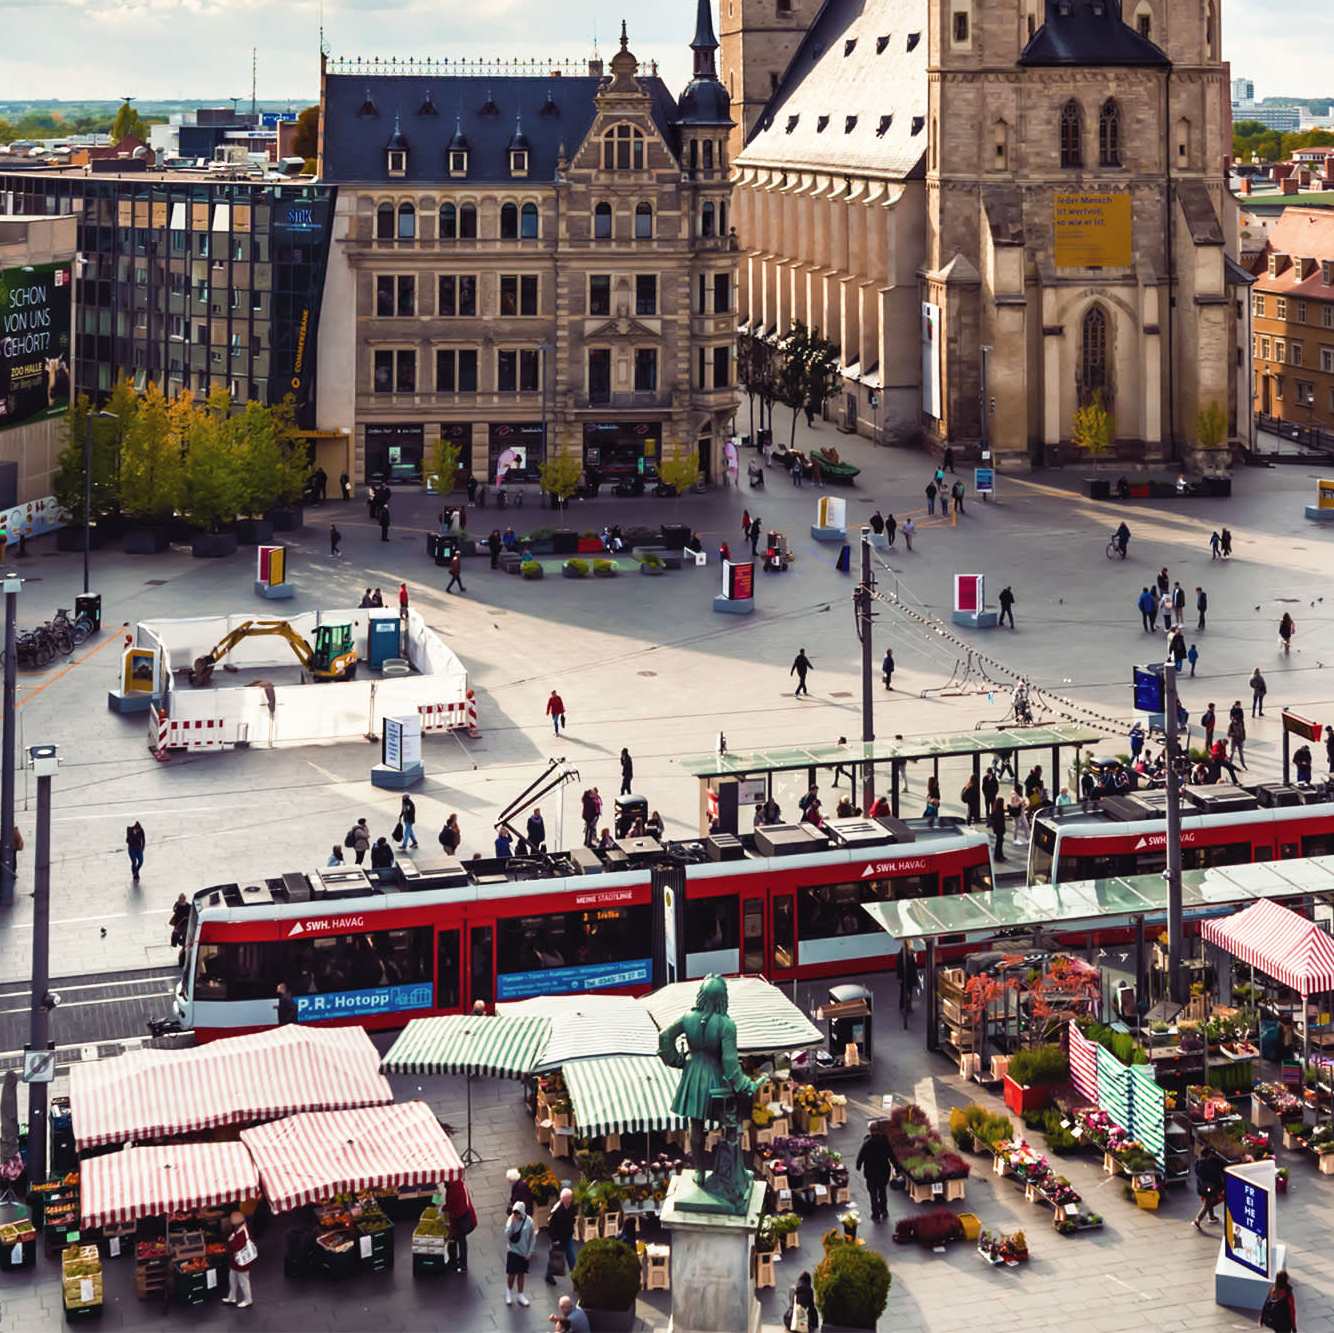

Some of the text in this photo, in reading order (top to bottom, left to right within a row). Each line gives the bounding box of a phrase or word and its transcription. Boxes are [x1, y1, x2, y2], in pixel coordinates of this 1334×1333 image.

[9, 284, 47, 309] SCHON
[3, 307, 51, 334] VON UNS
[3, 331, 51, 358] GEHÖRT?
[294, 308, 309, 374] COMMERZBANK
[10, 361, 43, 378] ZOO HALLE
[897, 858, 927, 871] HAVAG
[305, 916, 364, 932] SWH. HAVAG
[297, 994, 389, 1013] P.R. Hotopp
[1244, 1185, 1255, 1198] FR
[1246, 1196, 1255, 1208] EI
[1244, 1206, 1256, 1219] HE
[1246, 1216, 1255, 1228] IT
